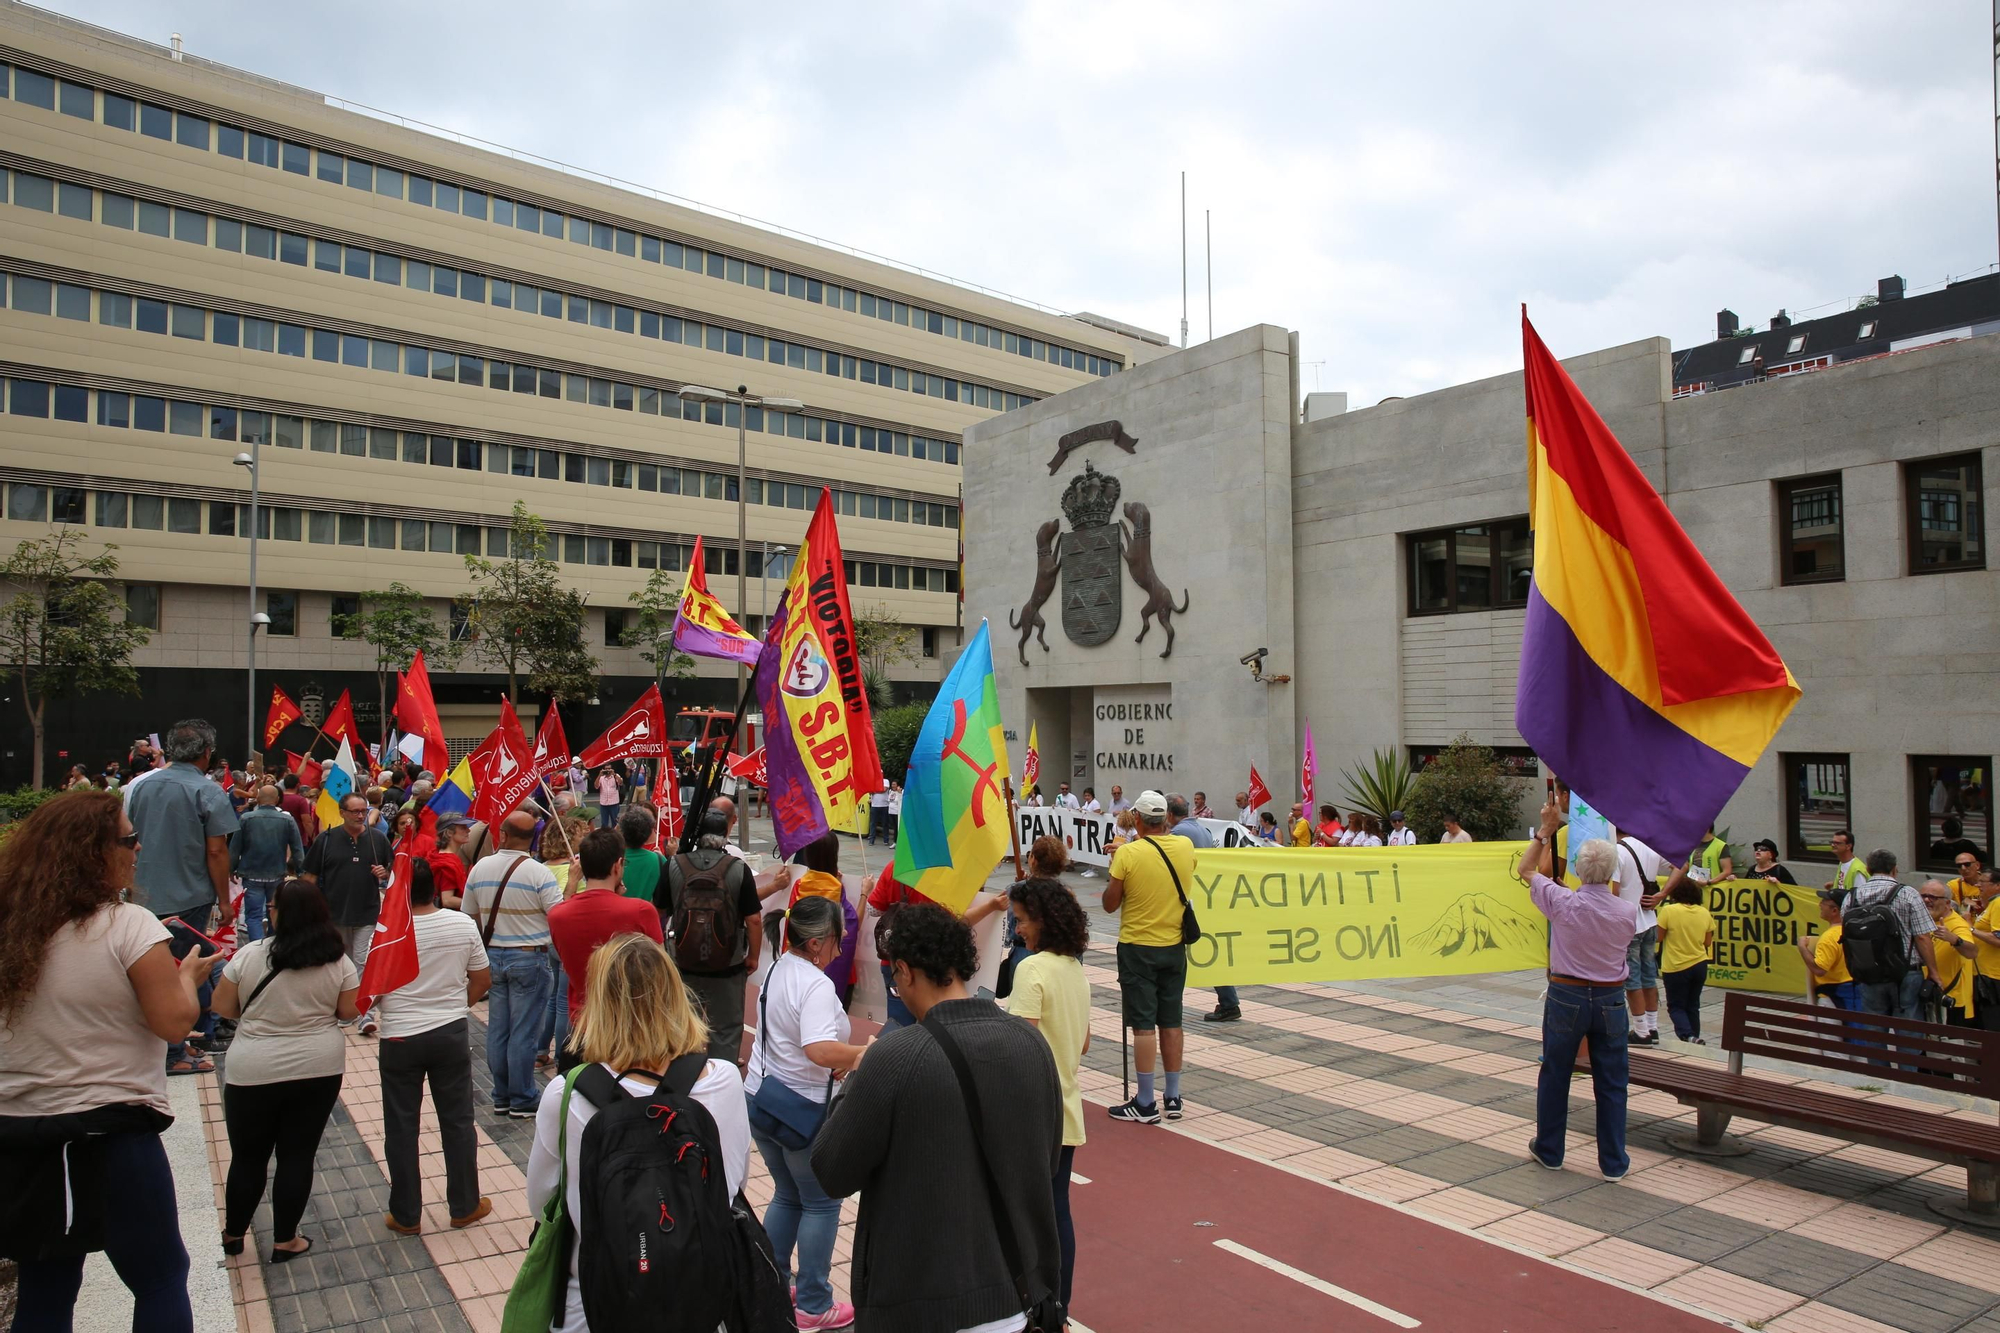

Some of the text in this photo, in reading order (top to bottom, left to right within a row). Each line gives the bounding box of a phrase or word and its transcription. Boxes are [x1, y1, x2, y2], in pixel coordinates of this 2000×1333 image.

[1124, 728, 1144, 745] DE
[799, 700, 855, 808] S.B.T.
[1021, 814, 1063, 845] PAN
[1709, 888, 1794, 917] DIGNO
[1712, 914, 1820, 946] TENIBLE
[638, 1232, 648, 1271] URBAN 20
